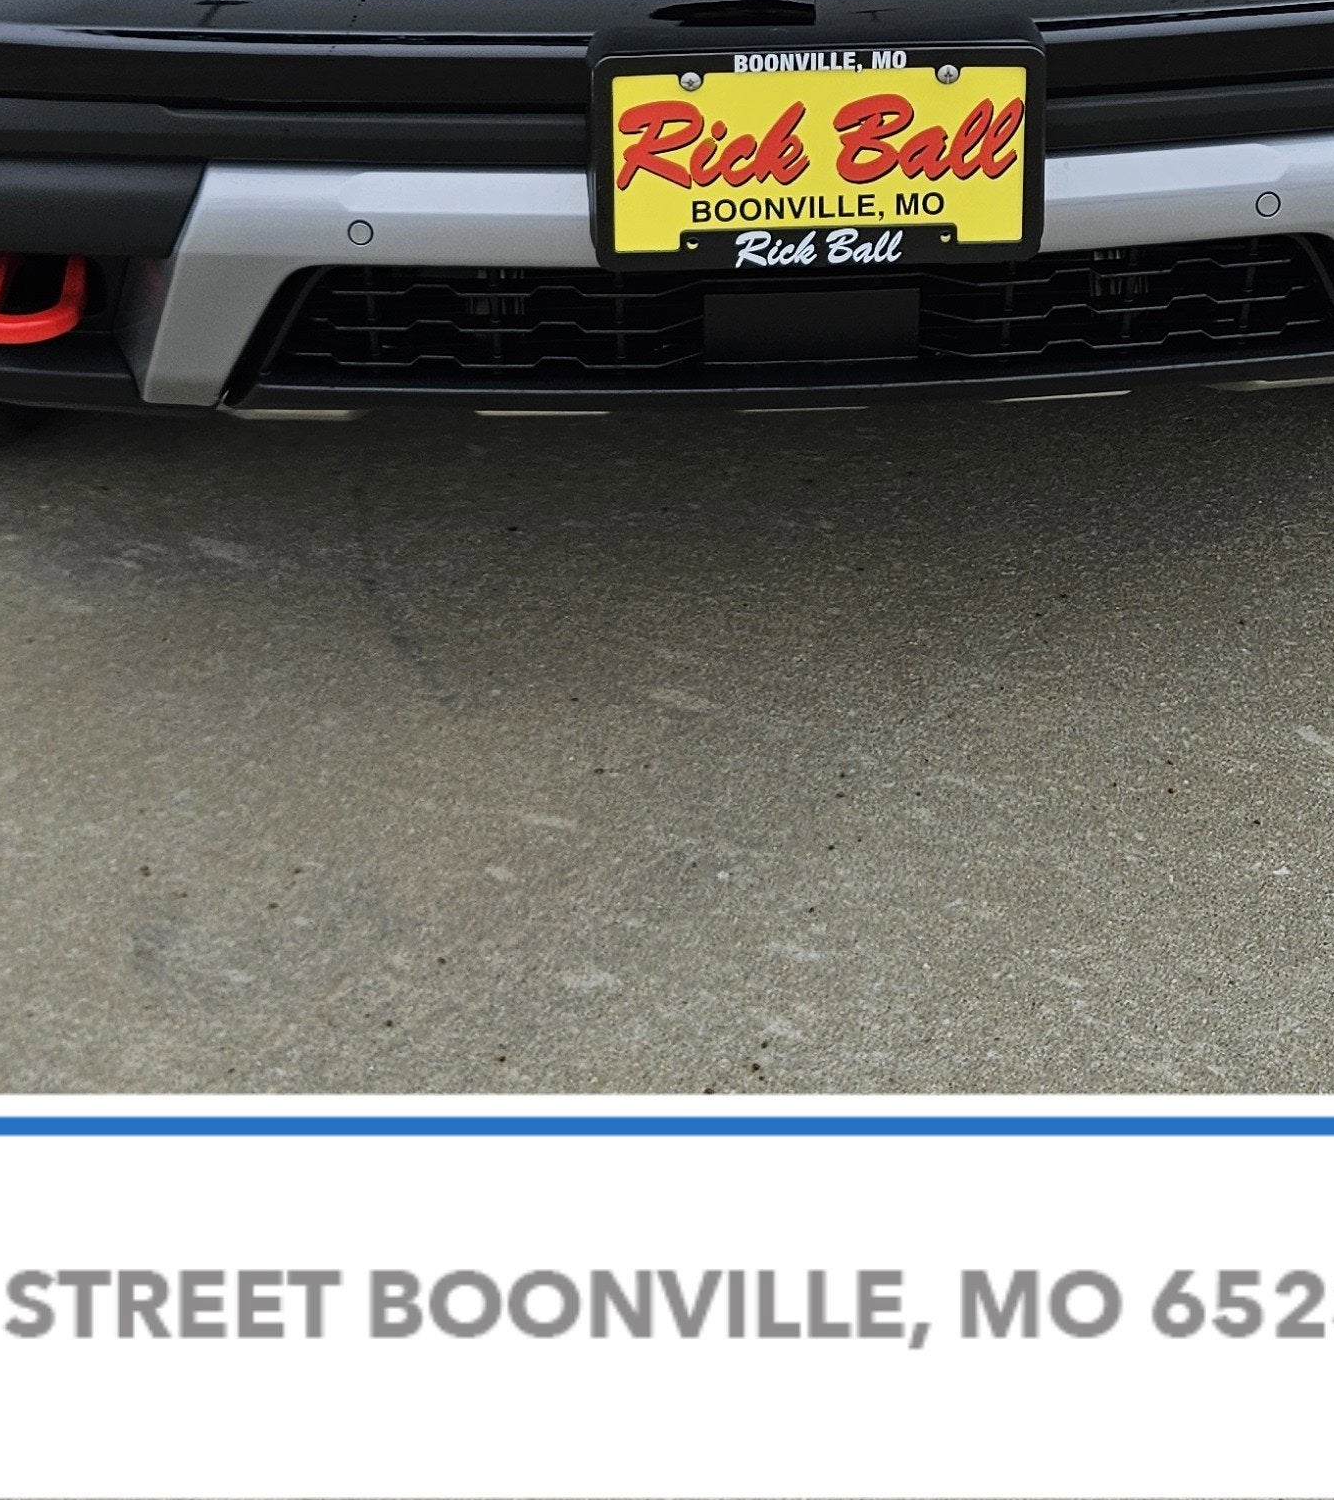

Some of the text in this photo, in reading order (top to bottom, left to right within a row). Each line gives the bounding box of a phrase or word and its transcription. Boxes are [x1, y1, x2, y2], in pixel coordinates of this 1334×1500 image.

[733, 50, 907, 74] BOONVILLE, MO
[616, 93, 1025, 191] Rick Ball
[691, 192, 945, 224] BOONVILLE, MO
[734, 228, 904, 269] Rick Ball
